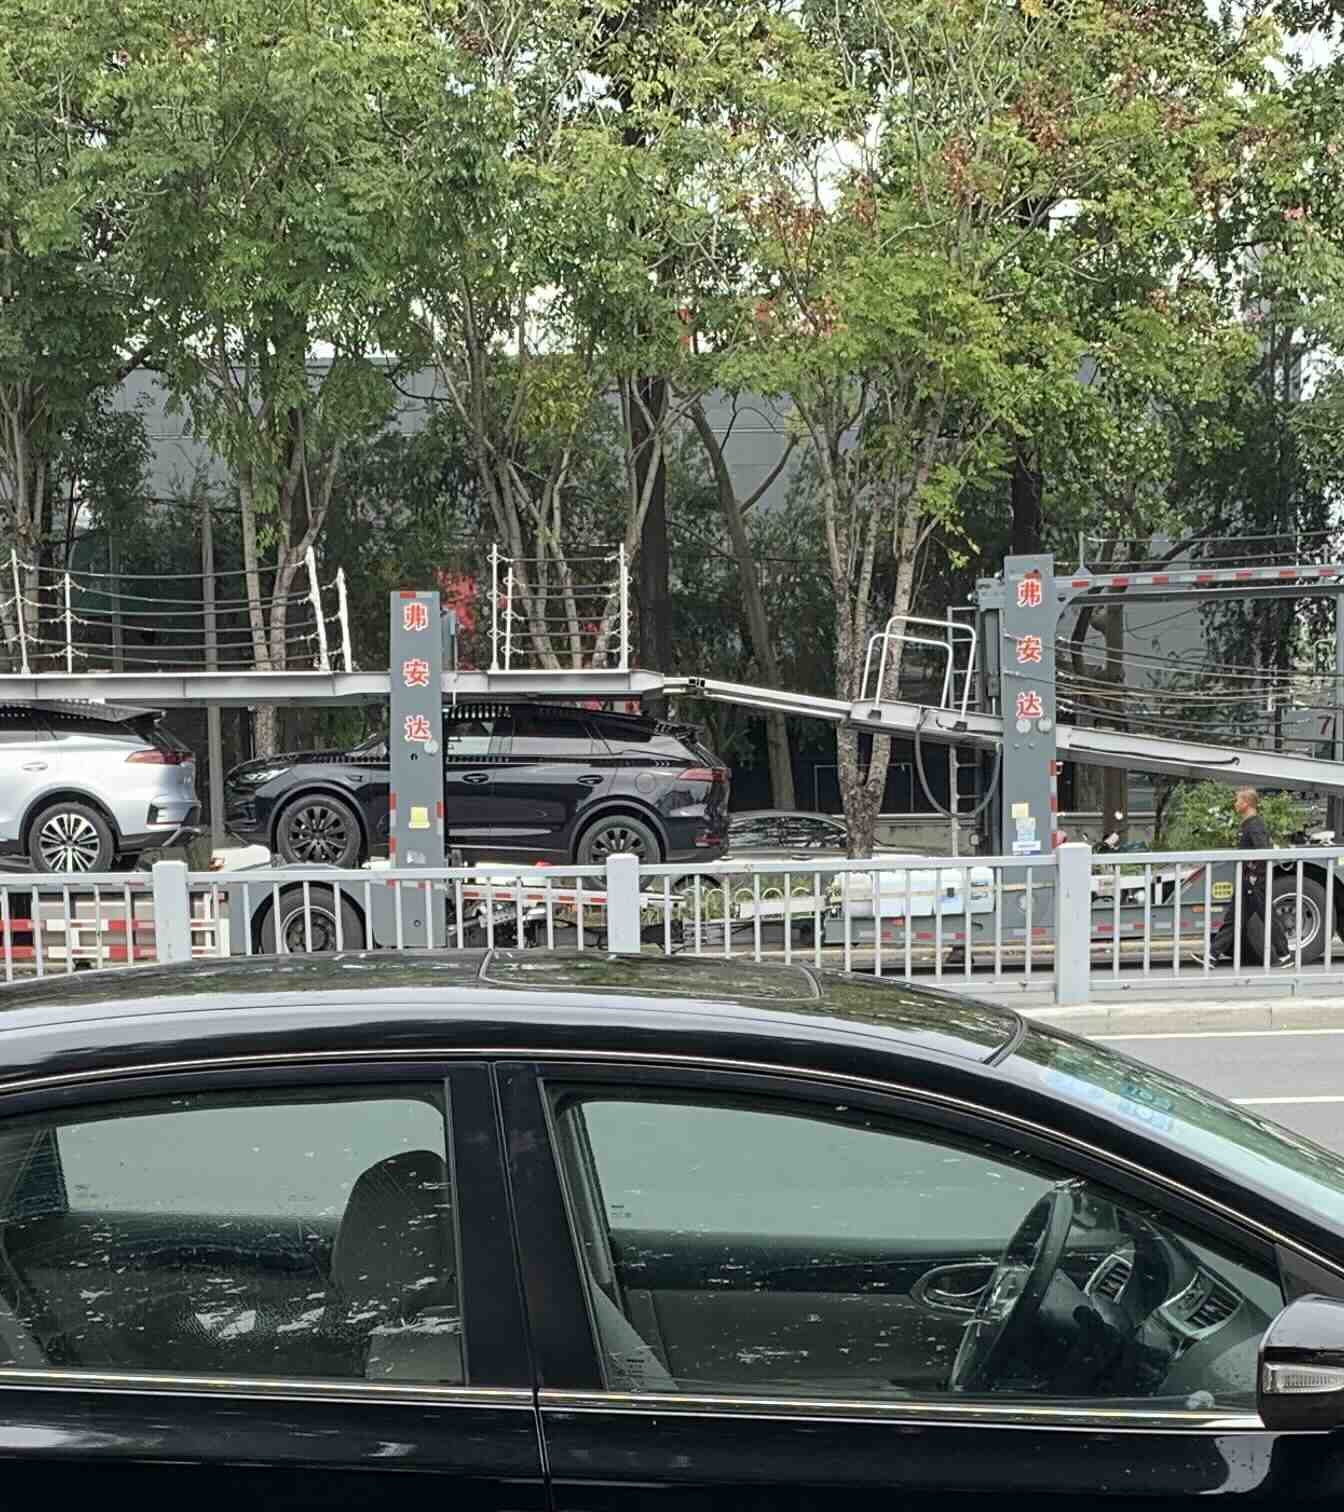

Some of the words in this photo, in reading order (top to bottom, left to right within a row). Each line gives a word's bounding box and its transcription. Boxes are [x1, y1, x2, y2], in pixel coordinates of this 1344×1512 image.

[403, 602, 432, 742] 弗安达
[1016, 579, 1043, 720] 弗安达
